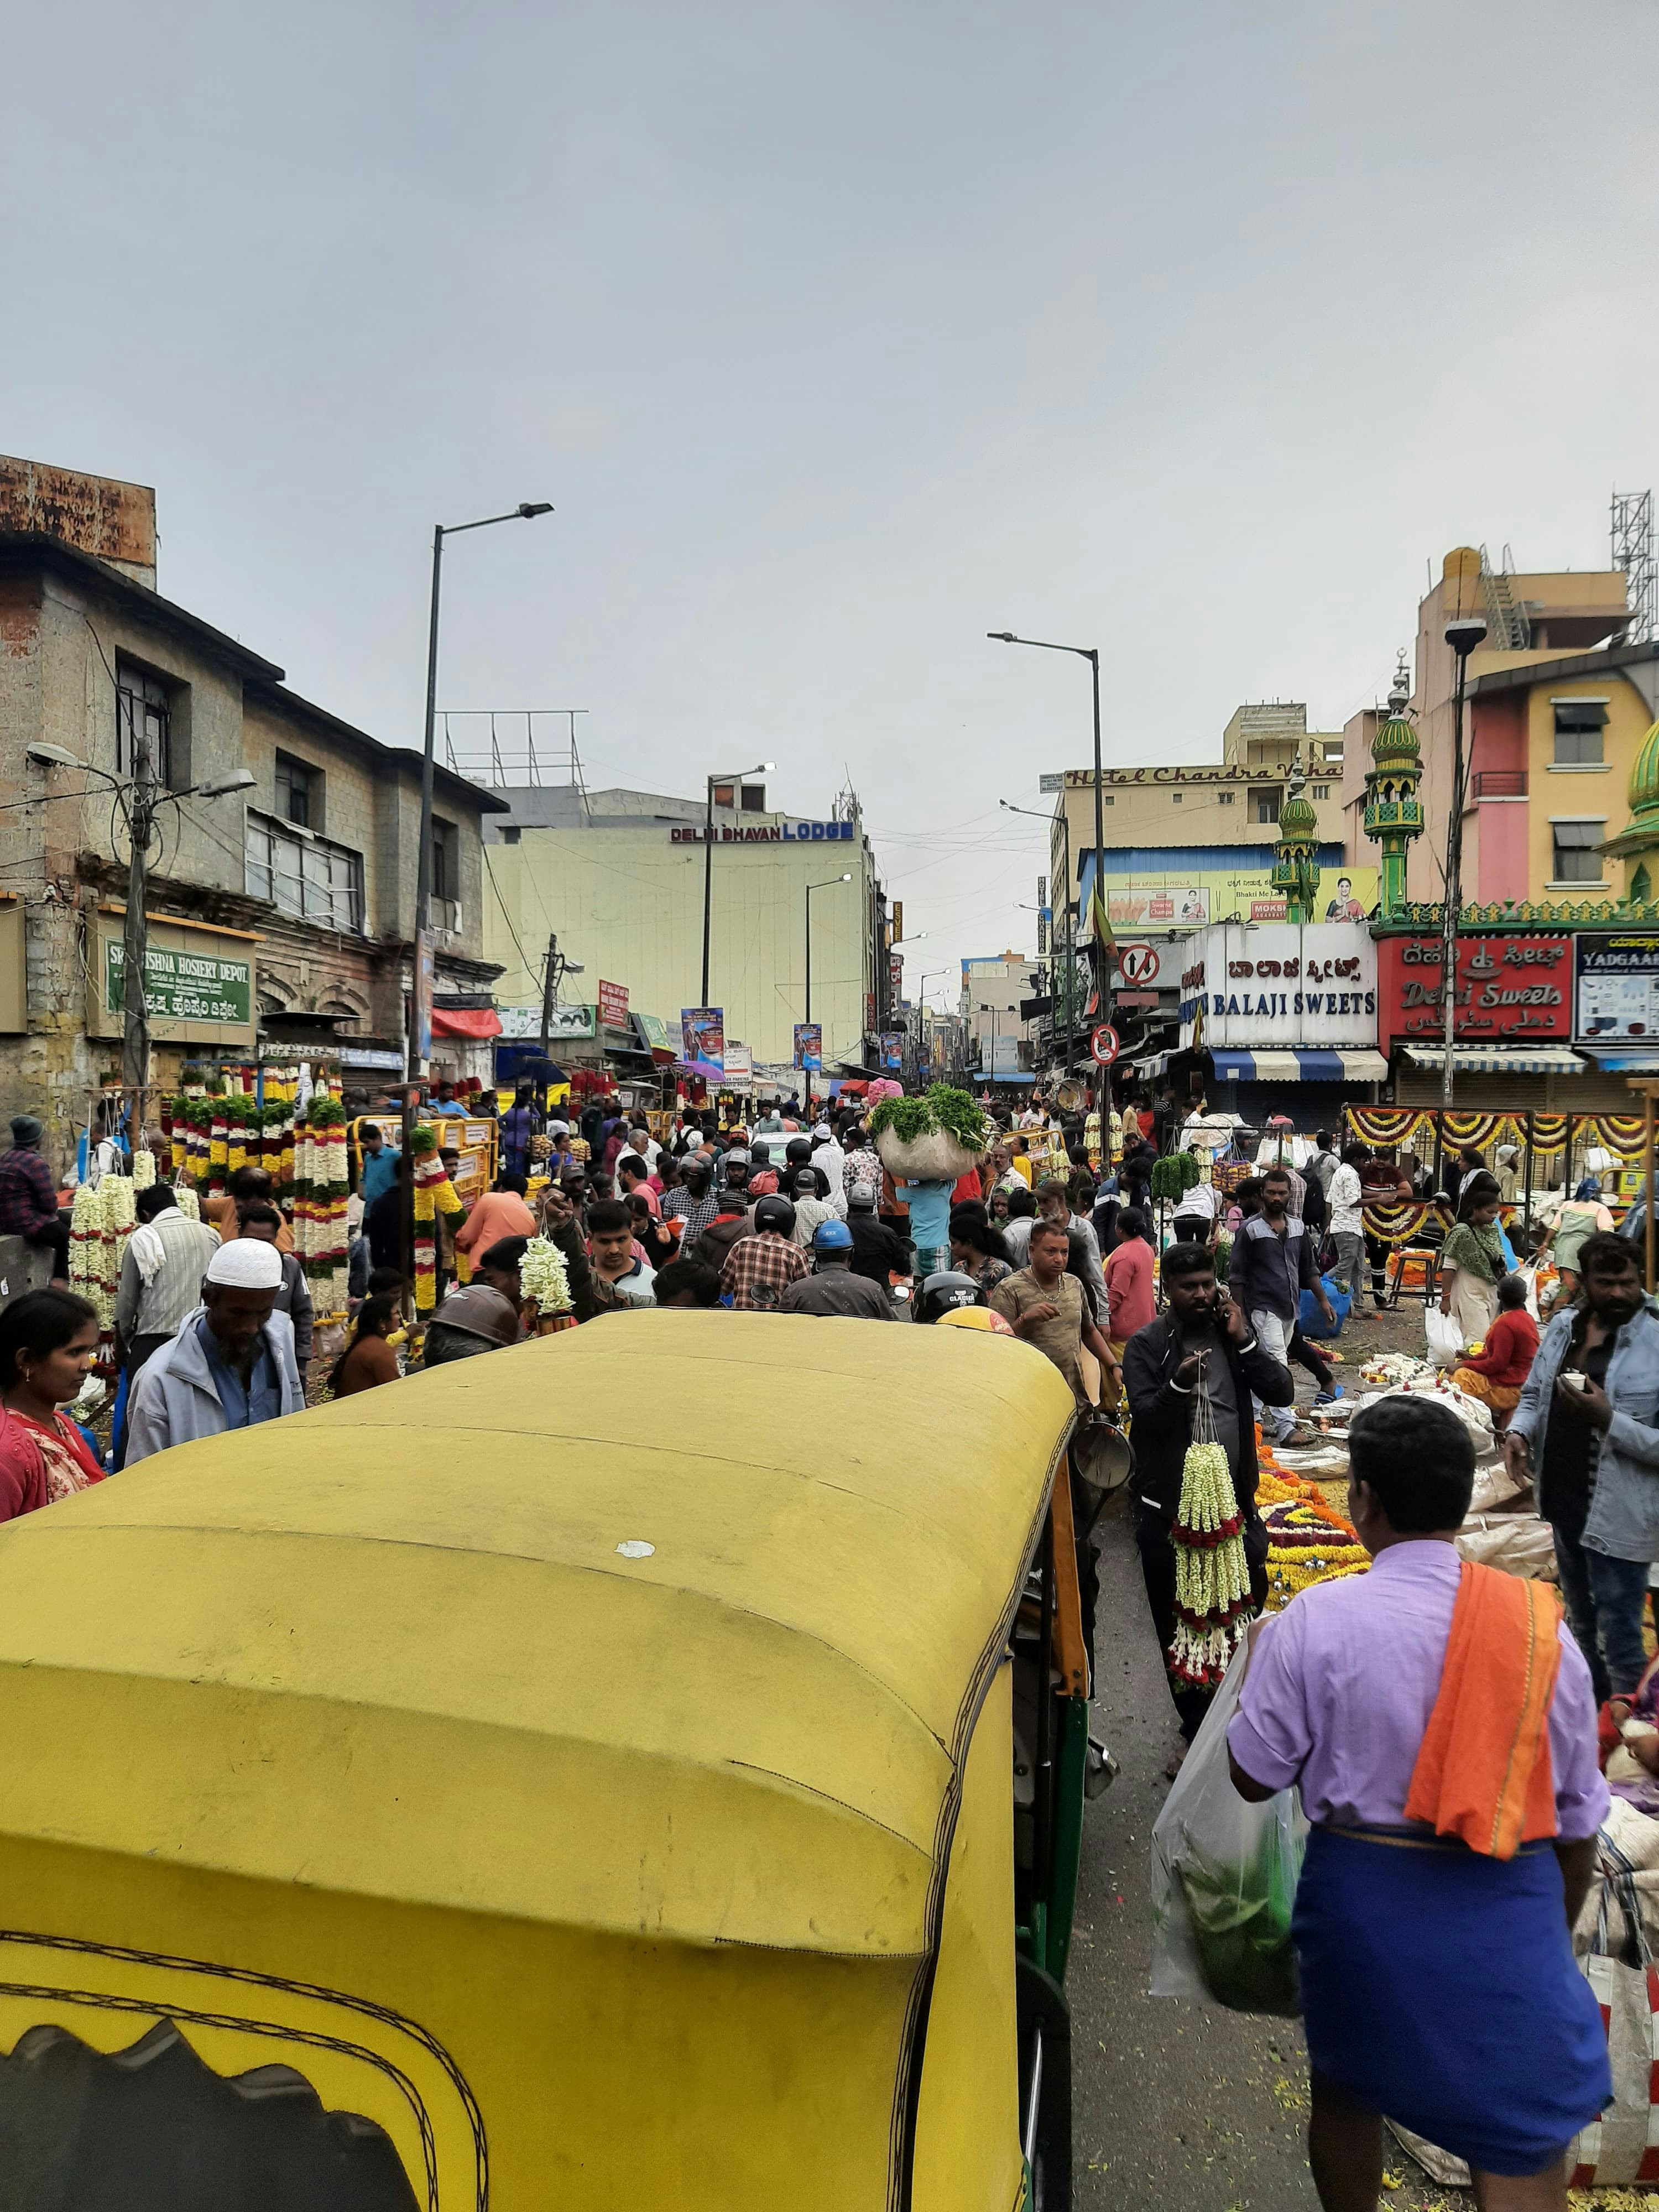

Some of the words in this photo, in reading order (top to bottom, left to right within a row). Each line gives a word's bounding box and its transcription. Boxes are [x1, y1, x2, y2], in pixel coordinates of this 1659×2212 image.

[1066, 769, 1145, 785] Htel
[1154, 765, 1273, 782] Chandra
[1277, 763, 1344, 778] Vha
[782, 822, 853, 840] LODGE
[178, 956, 217, 979] HOSIERY
[220, 963, 248, 983] DEPOT
[1228, 957, 1300, 978] ಬಾಲಾಜಿ
[1213, 994, 1288, 1019] BALAJI
[1294, 992, 1375, 1015] SWEETS
[1478, 983, 1562, 1008] Sweets
